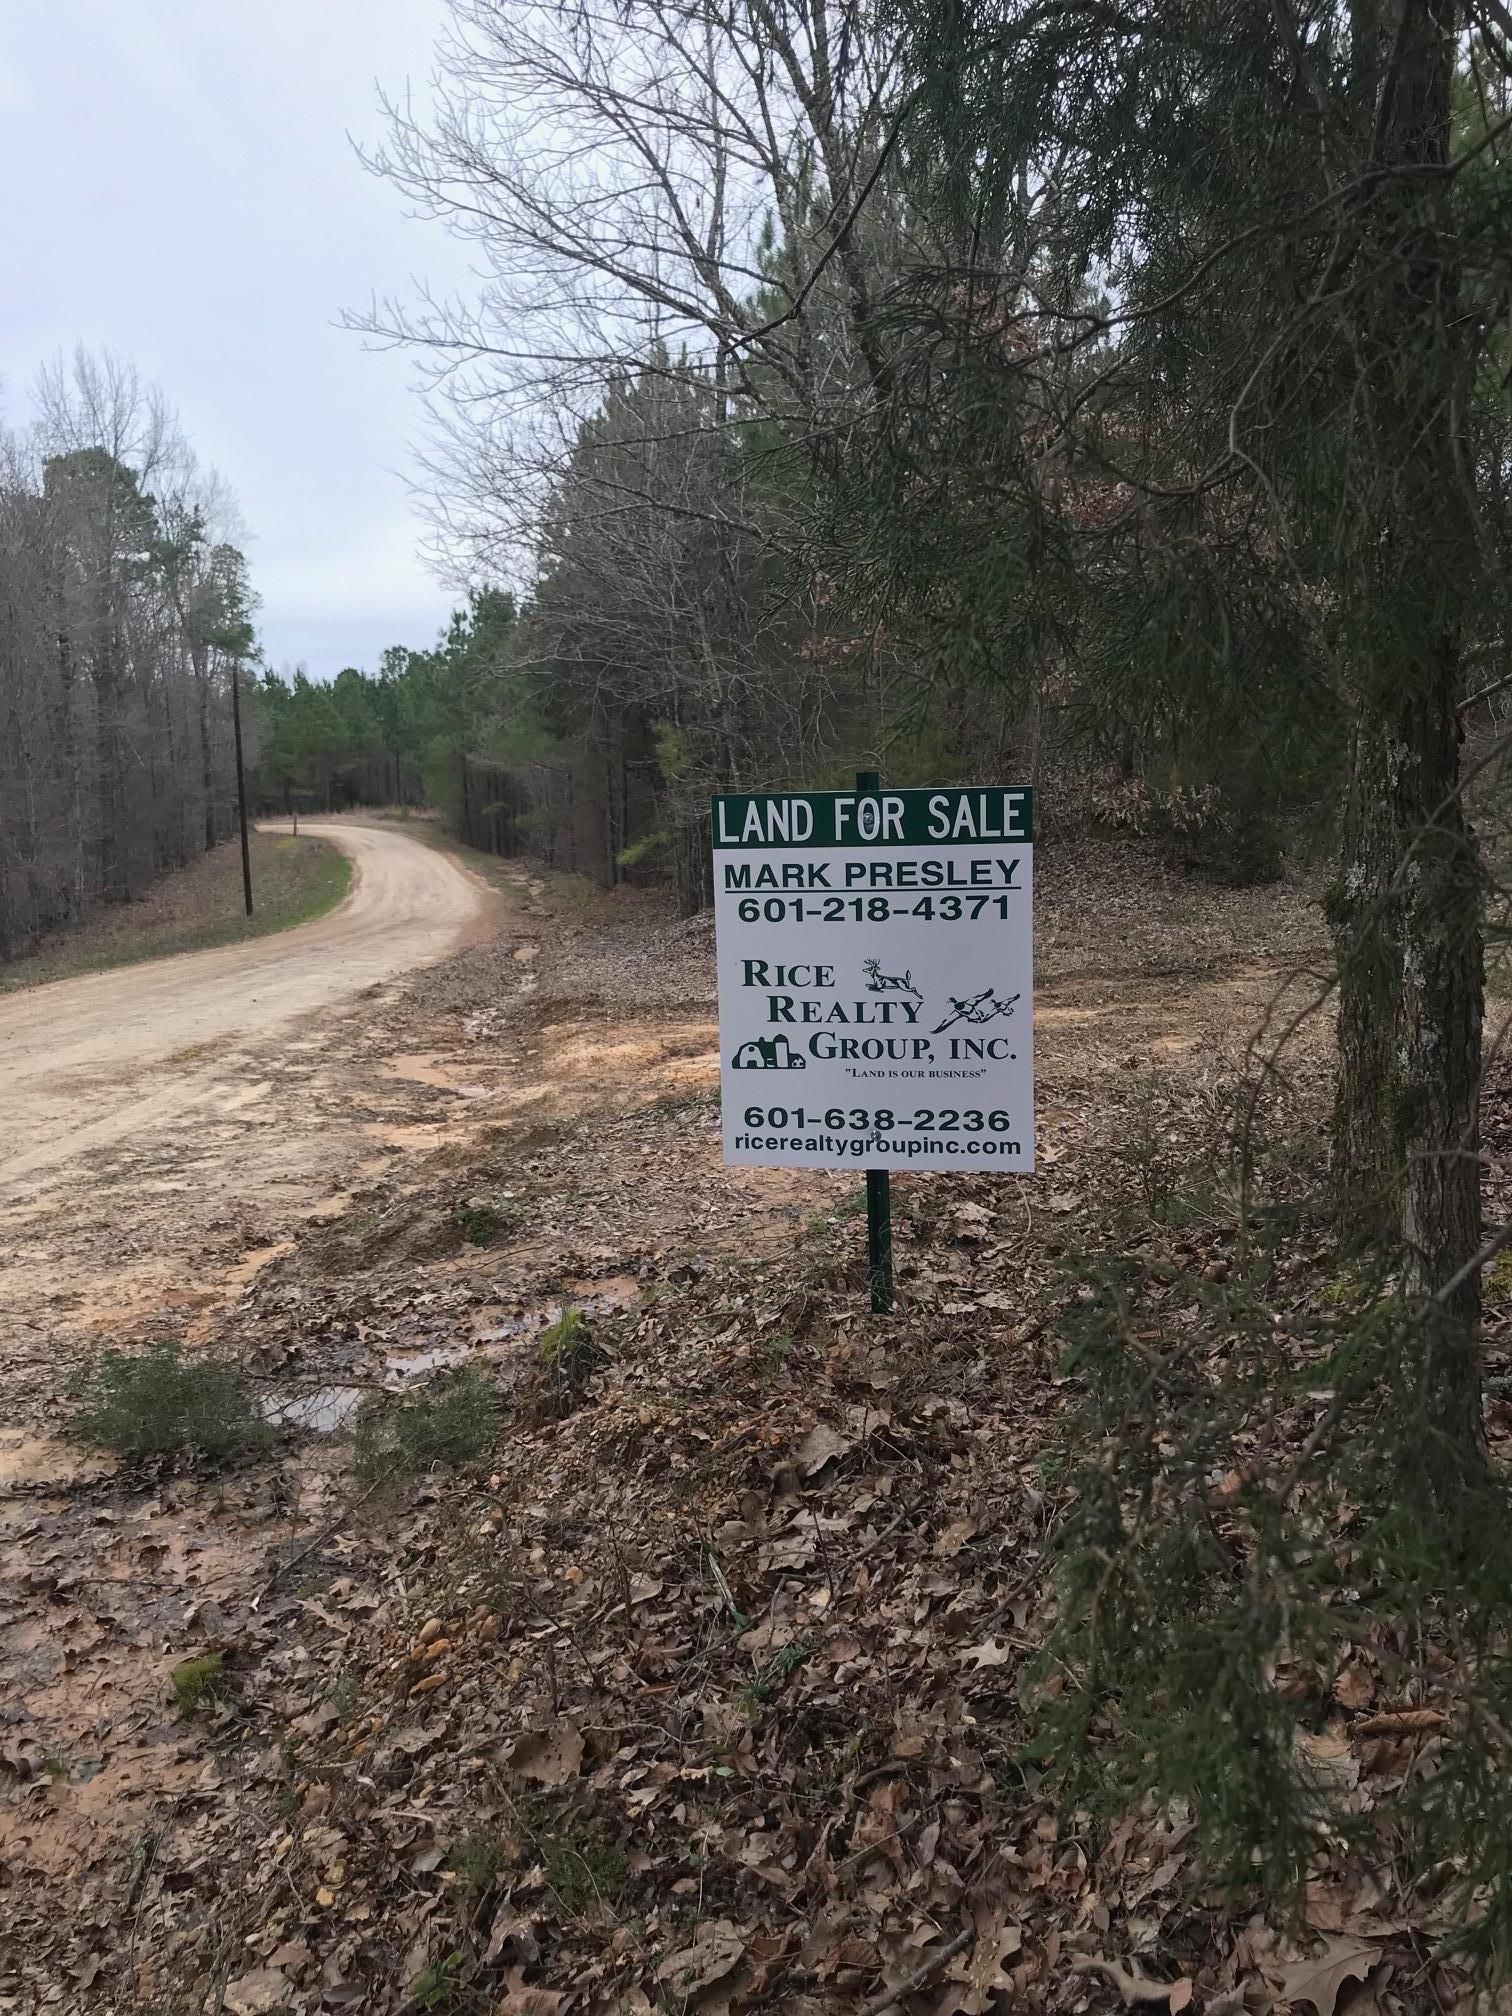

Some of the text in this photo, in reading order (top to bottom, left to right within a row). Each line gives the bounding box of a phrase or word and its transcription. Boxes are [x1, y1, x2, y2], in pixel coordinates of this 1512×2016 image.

[718, 793, 1025, 843] LAND FOR SALE
[724, 859, 1021, 888] MARK PRESLEY
[738, 895, 1009, 923] 601-218-4371
[740, 959, 836, 987] RICE
[766, 995, 925, 1024] REALTY
[808, 1031, 1017, 1064] GROUP, INC.
[888, 1070, 898, 1079] IS
[901, 1070, 925, 1079] OUR
[744, 1106, 1011, 1132] 601-638-2236
[735, 1133, 1021, 1158] ricerealtygroupinc.com
